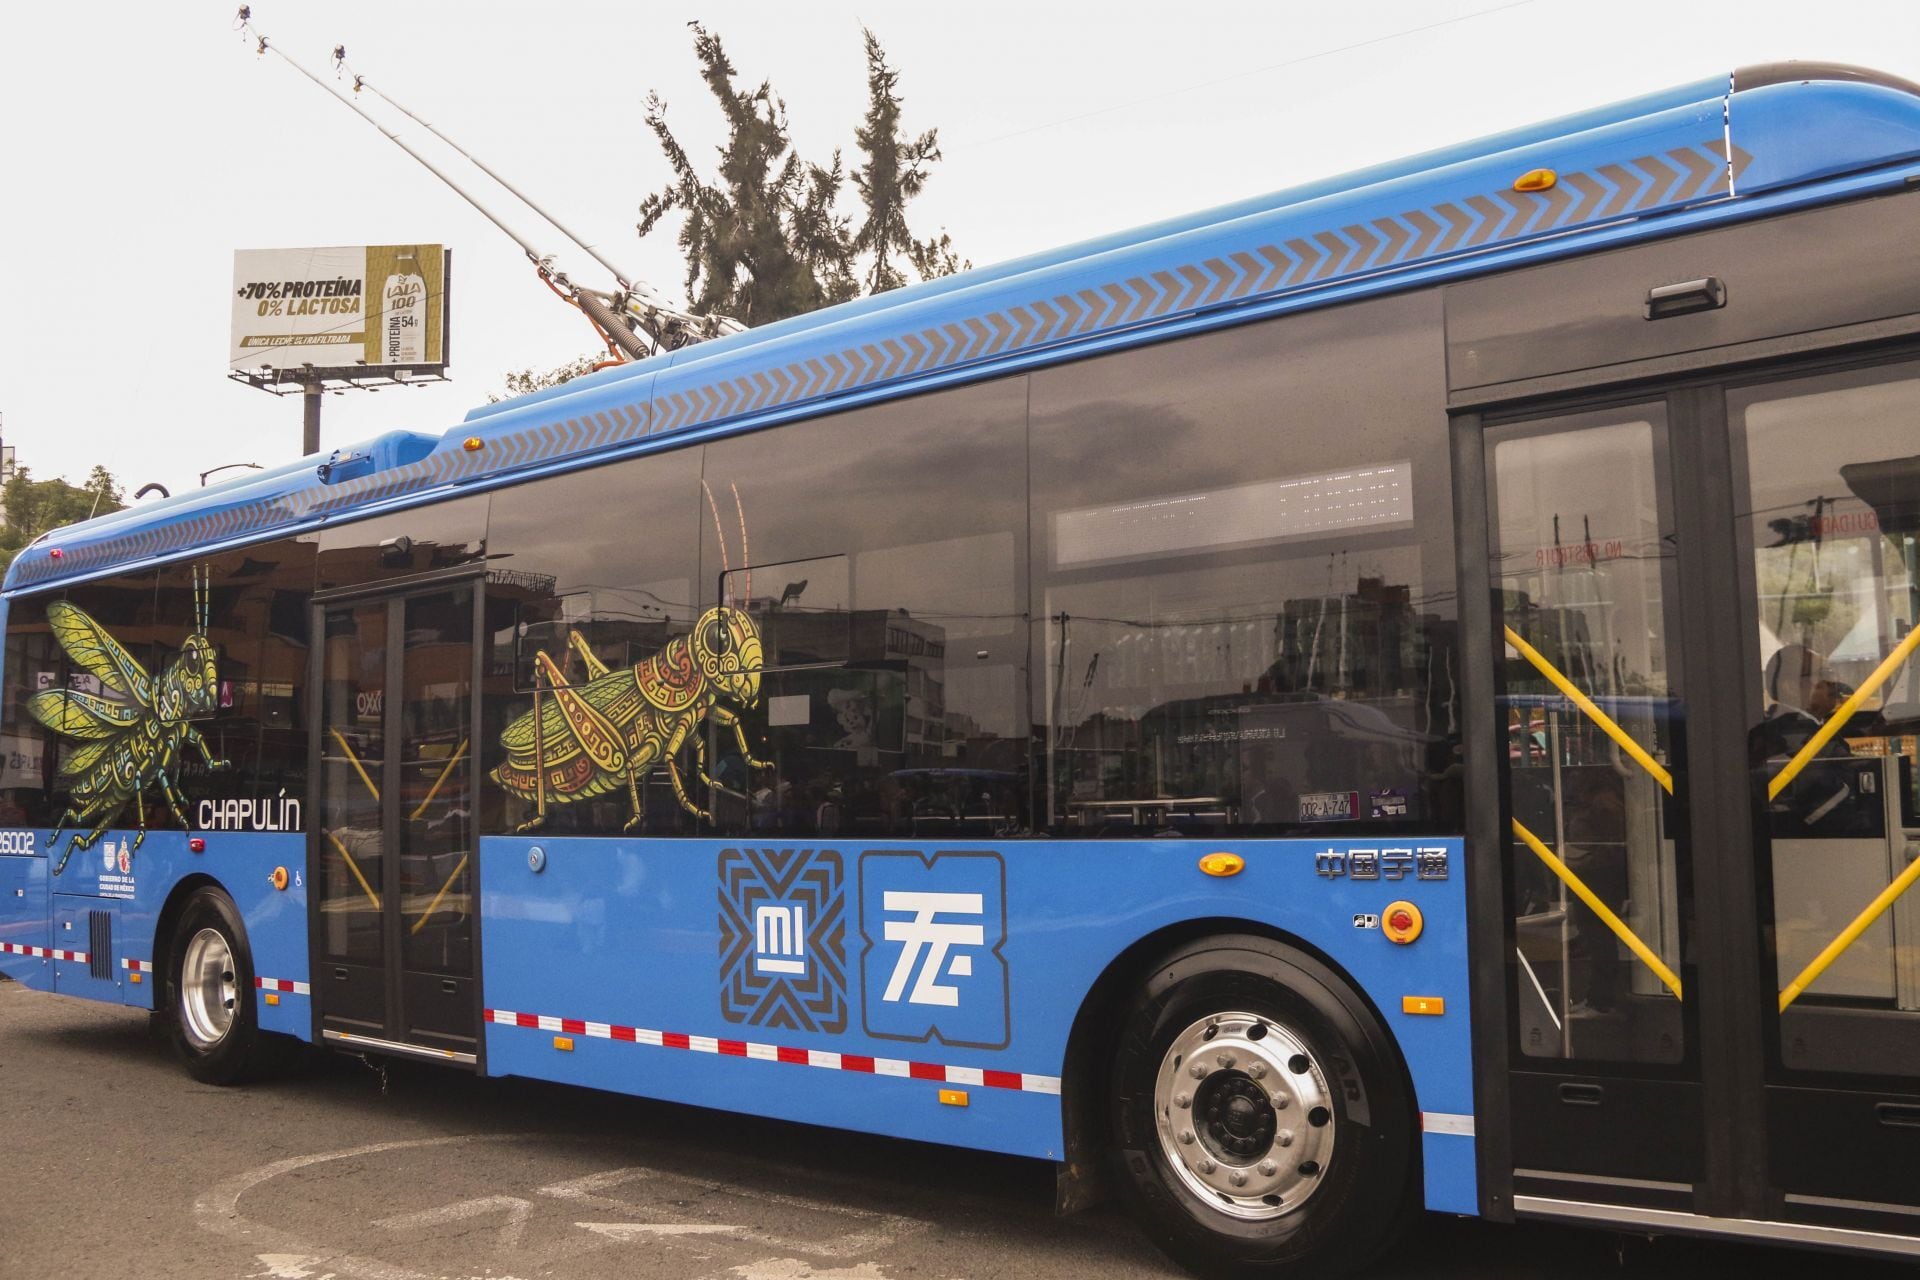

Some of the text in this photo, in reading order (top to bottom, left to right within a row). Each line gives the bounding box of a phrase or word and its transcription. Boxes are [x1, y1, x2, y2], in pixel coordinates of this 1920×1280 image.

[237, 276, 361, 299] +70% PROTEÍNA
[387, 283, 421, 298] LALA
[257, 297, 360, 316] 0% LACTOSA
[401, 315, 414, 327] 54
[1315, 847, 1449, 880] 中国宇通
